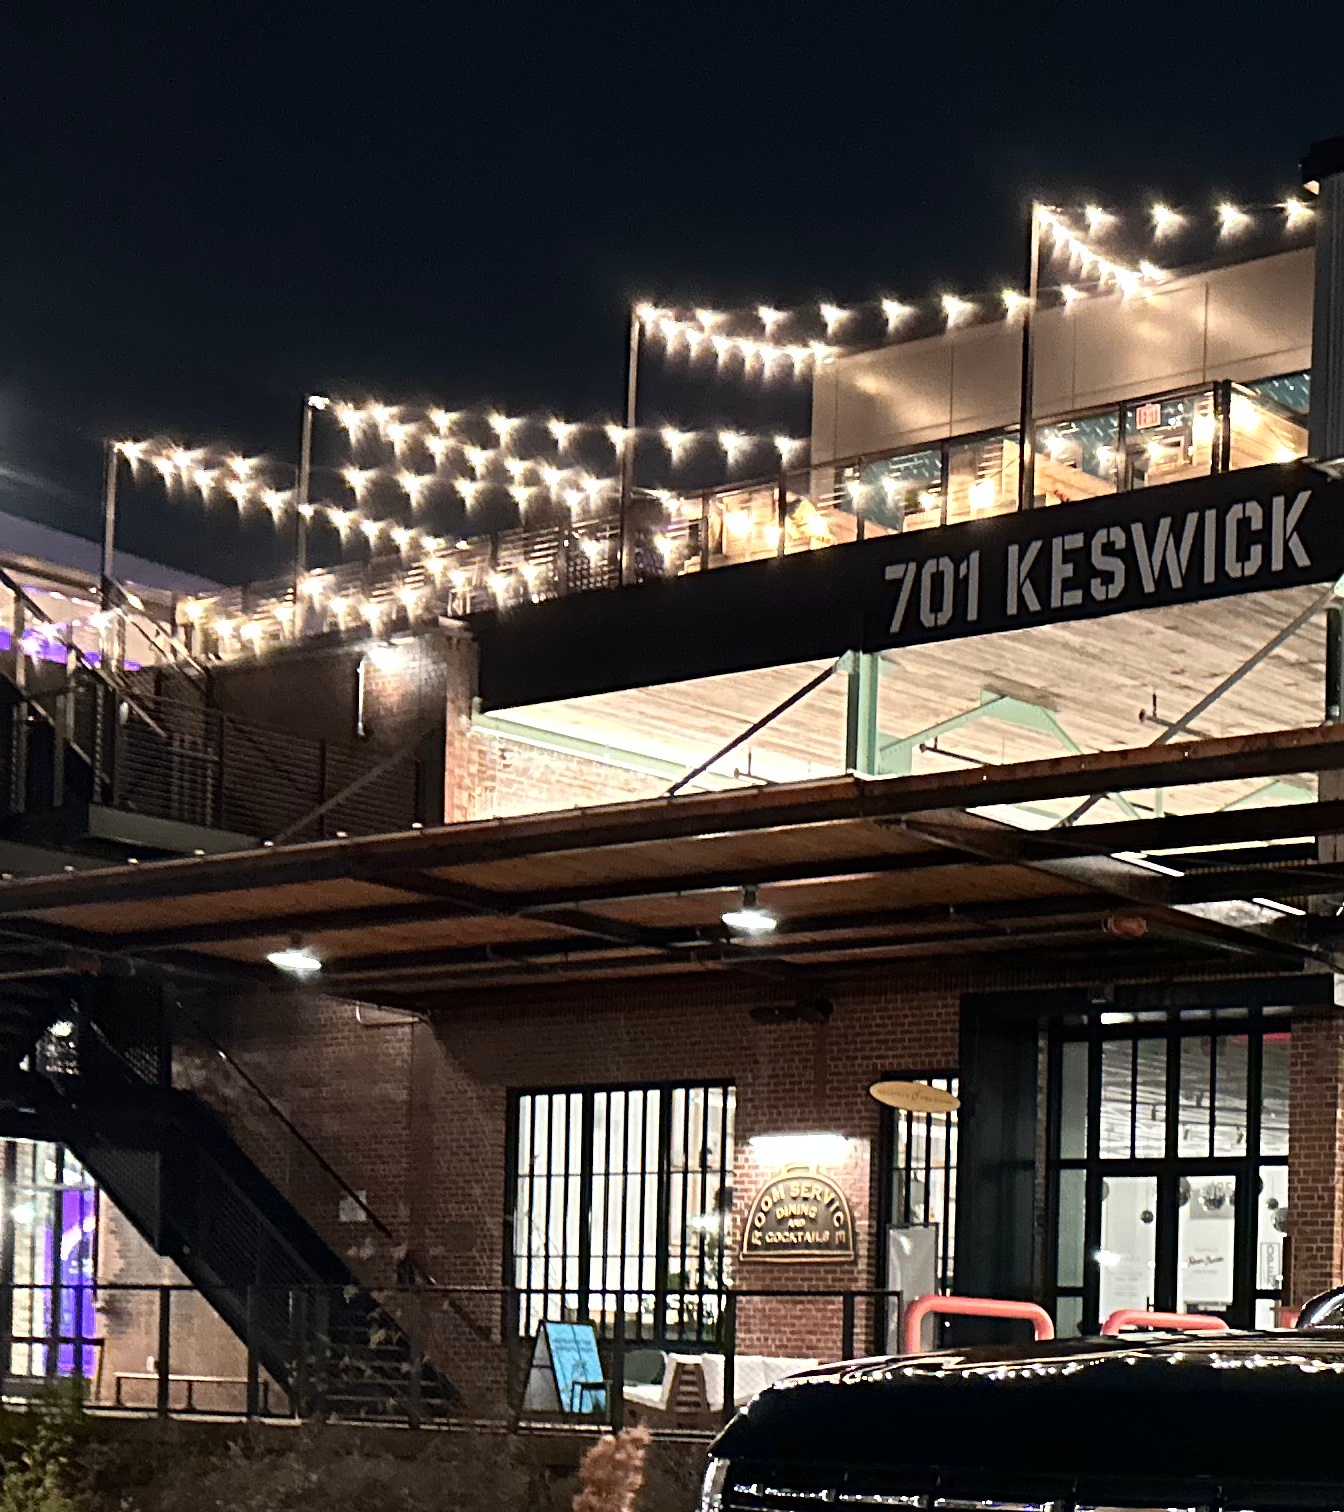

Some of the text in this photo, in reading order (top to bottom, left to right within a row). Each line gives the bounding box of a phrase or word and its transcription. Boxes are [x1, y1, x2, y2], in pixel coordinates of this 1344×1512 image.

[884, 489, 1313, 635] 701 KESWICK
[751, 1182, 846, 1245] ROOM SERVICE
[775, 1203, 818, 1220] DINING
[765, 1230, 830, 1244] COCKTAILS
